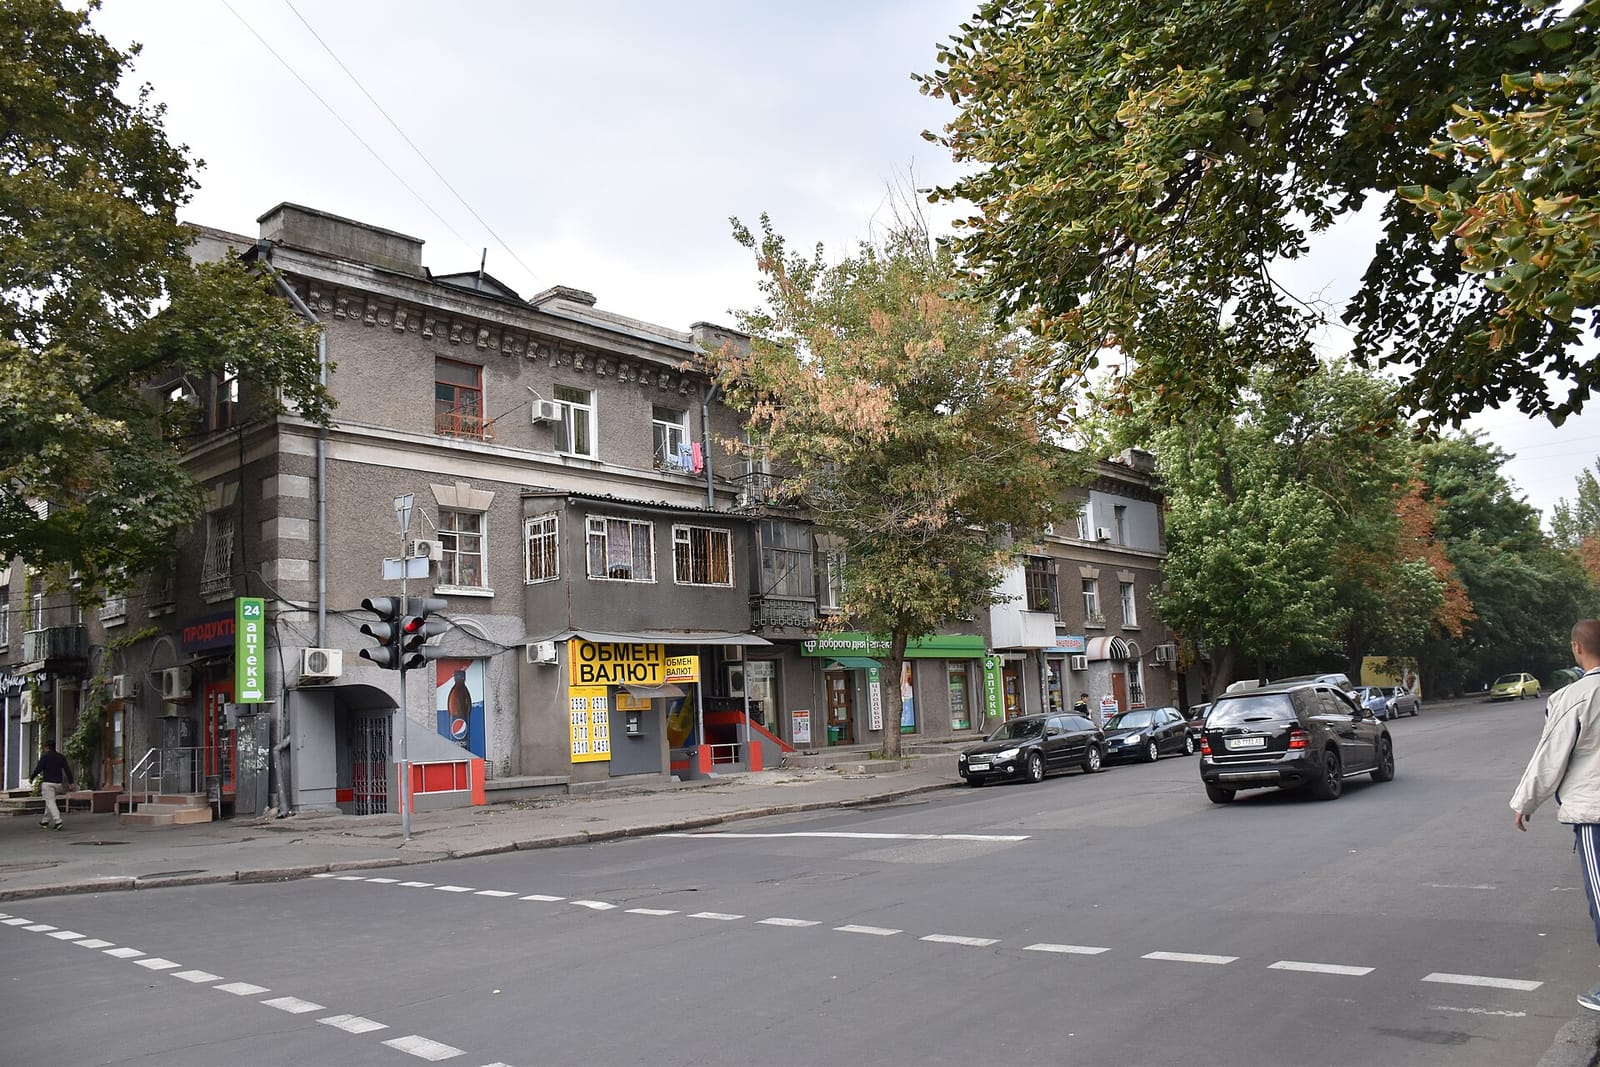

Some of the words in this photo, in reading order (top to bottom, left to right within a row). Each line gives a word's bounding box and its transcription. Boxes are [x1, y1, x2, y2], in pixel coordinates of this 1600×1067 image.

[244, 605, 260, 616] 24
[818, 637, 851, 650] доброго
[852, 640, 866, 650] дня
[246, 622, 258, 687] аптека
[580, 643, 659, 662] ОБМЕН
[666, 657, 692, 667] ОБМЕН
[580, 663, 660, 683] ВАЛЮТ
[666, 667, 692, 676] ВАЛЮТ
[987, 672, 997, 716] аптека
